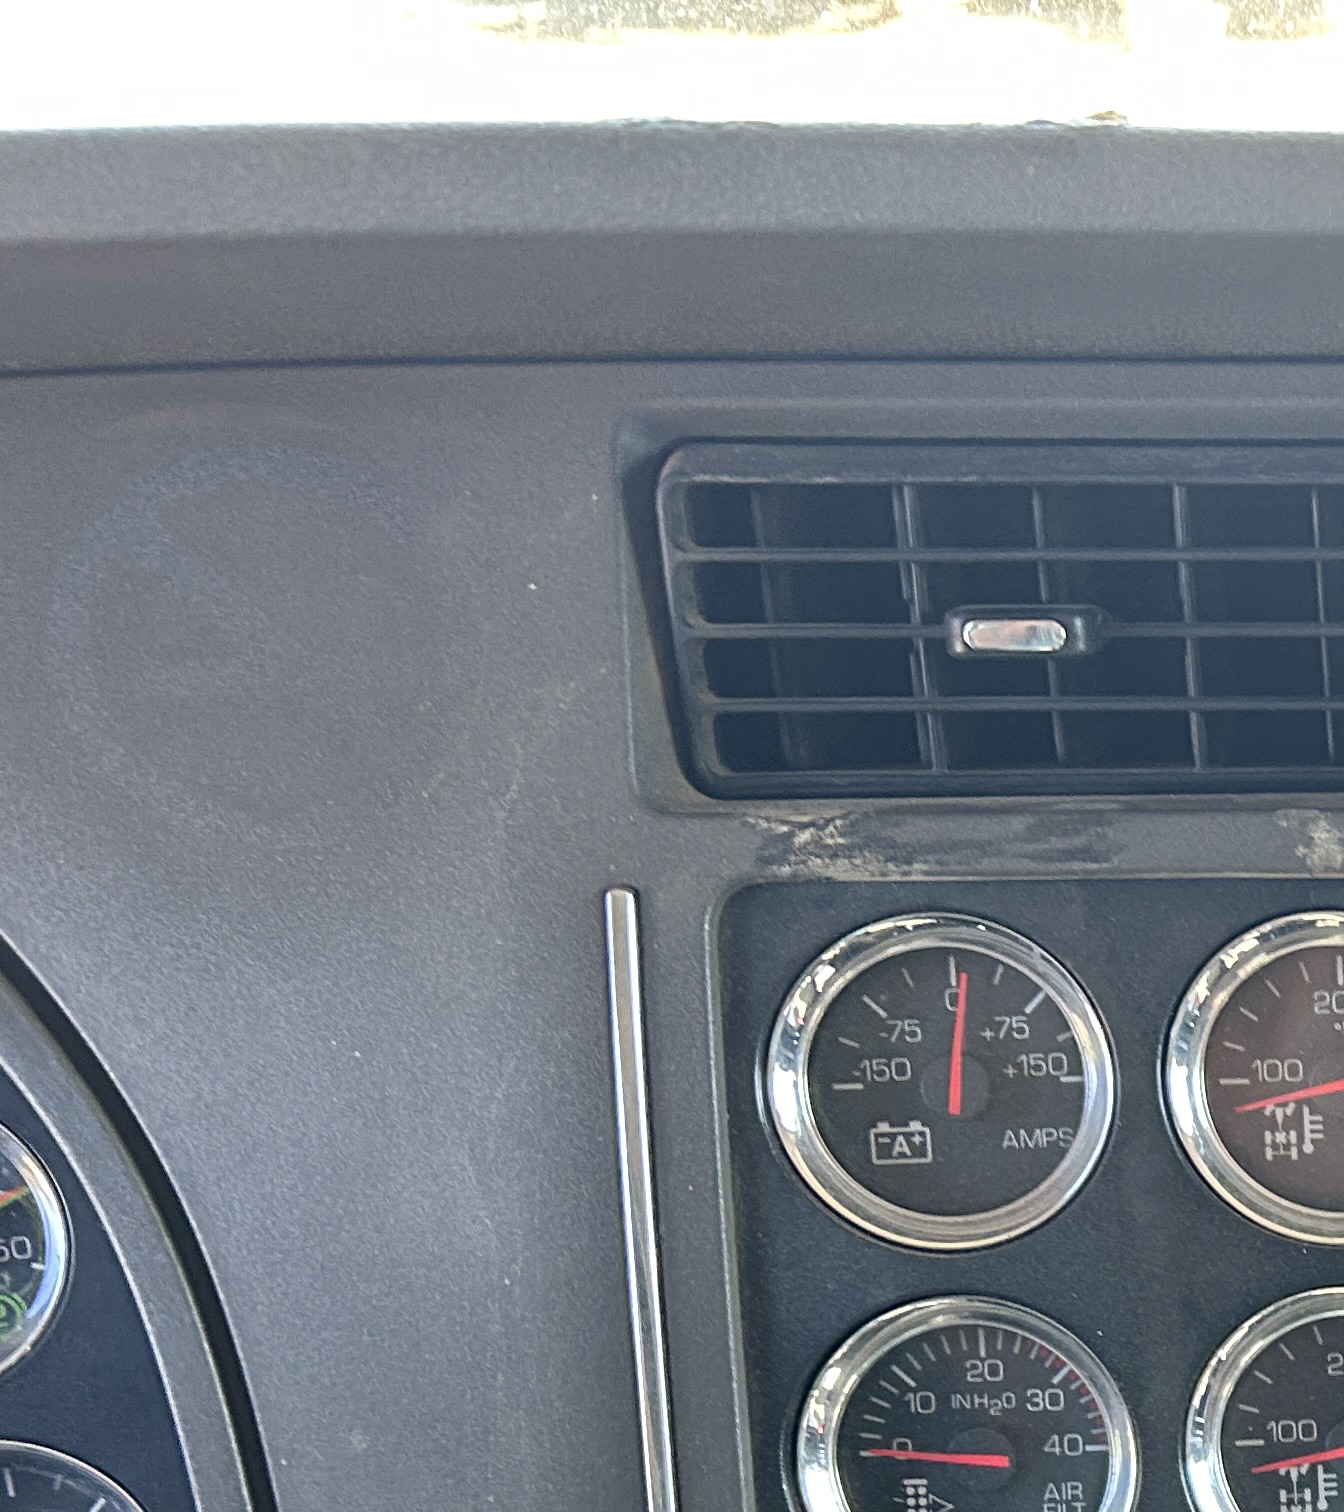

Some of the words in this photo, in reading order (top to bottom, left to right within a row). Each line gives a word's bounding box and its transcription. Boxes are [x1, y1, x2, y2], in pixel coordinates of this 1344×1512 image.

[879, 1019, 923, 1043] -75
[980, 1015, 1030, 1041] +75
[852, 1056, 911, 1082] -150
[1003, 1052, 1068, 1078] +150
[1252, 1059, 1303, 1083] 100
[1002, 1127, 1075, 1150] AMPS
[965, 1359, 1004, 1382] 20
[904, 1391, 936, 1415] 10
[1026, 1388, 1066, 1412] 30
[1266, 1419, 1317, 1443] 100
[1043, 1434, 1083, 1456] 40
[1043, 1482, 1083, 1501] AIR
